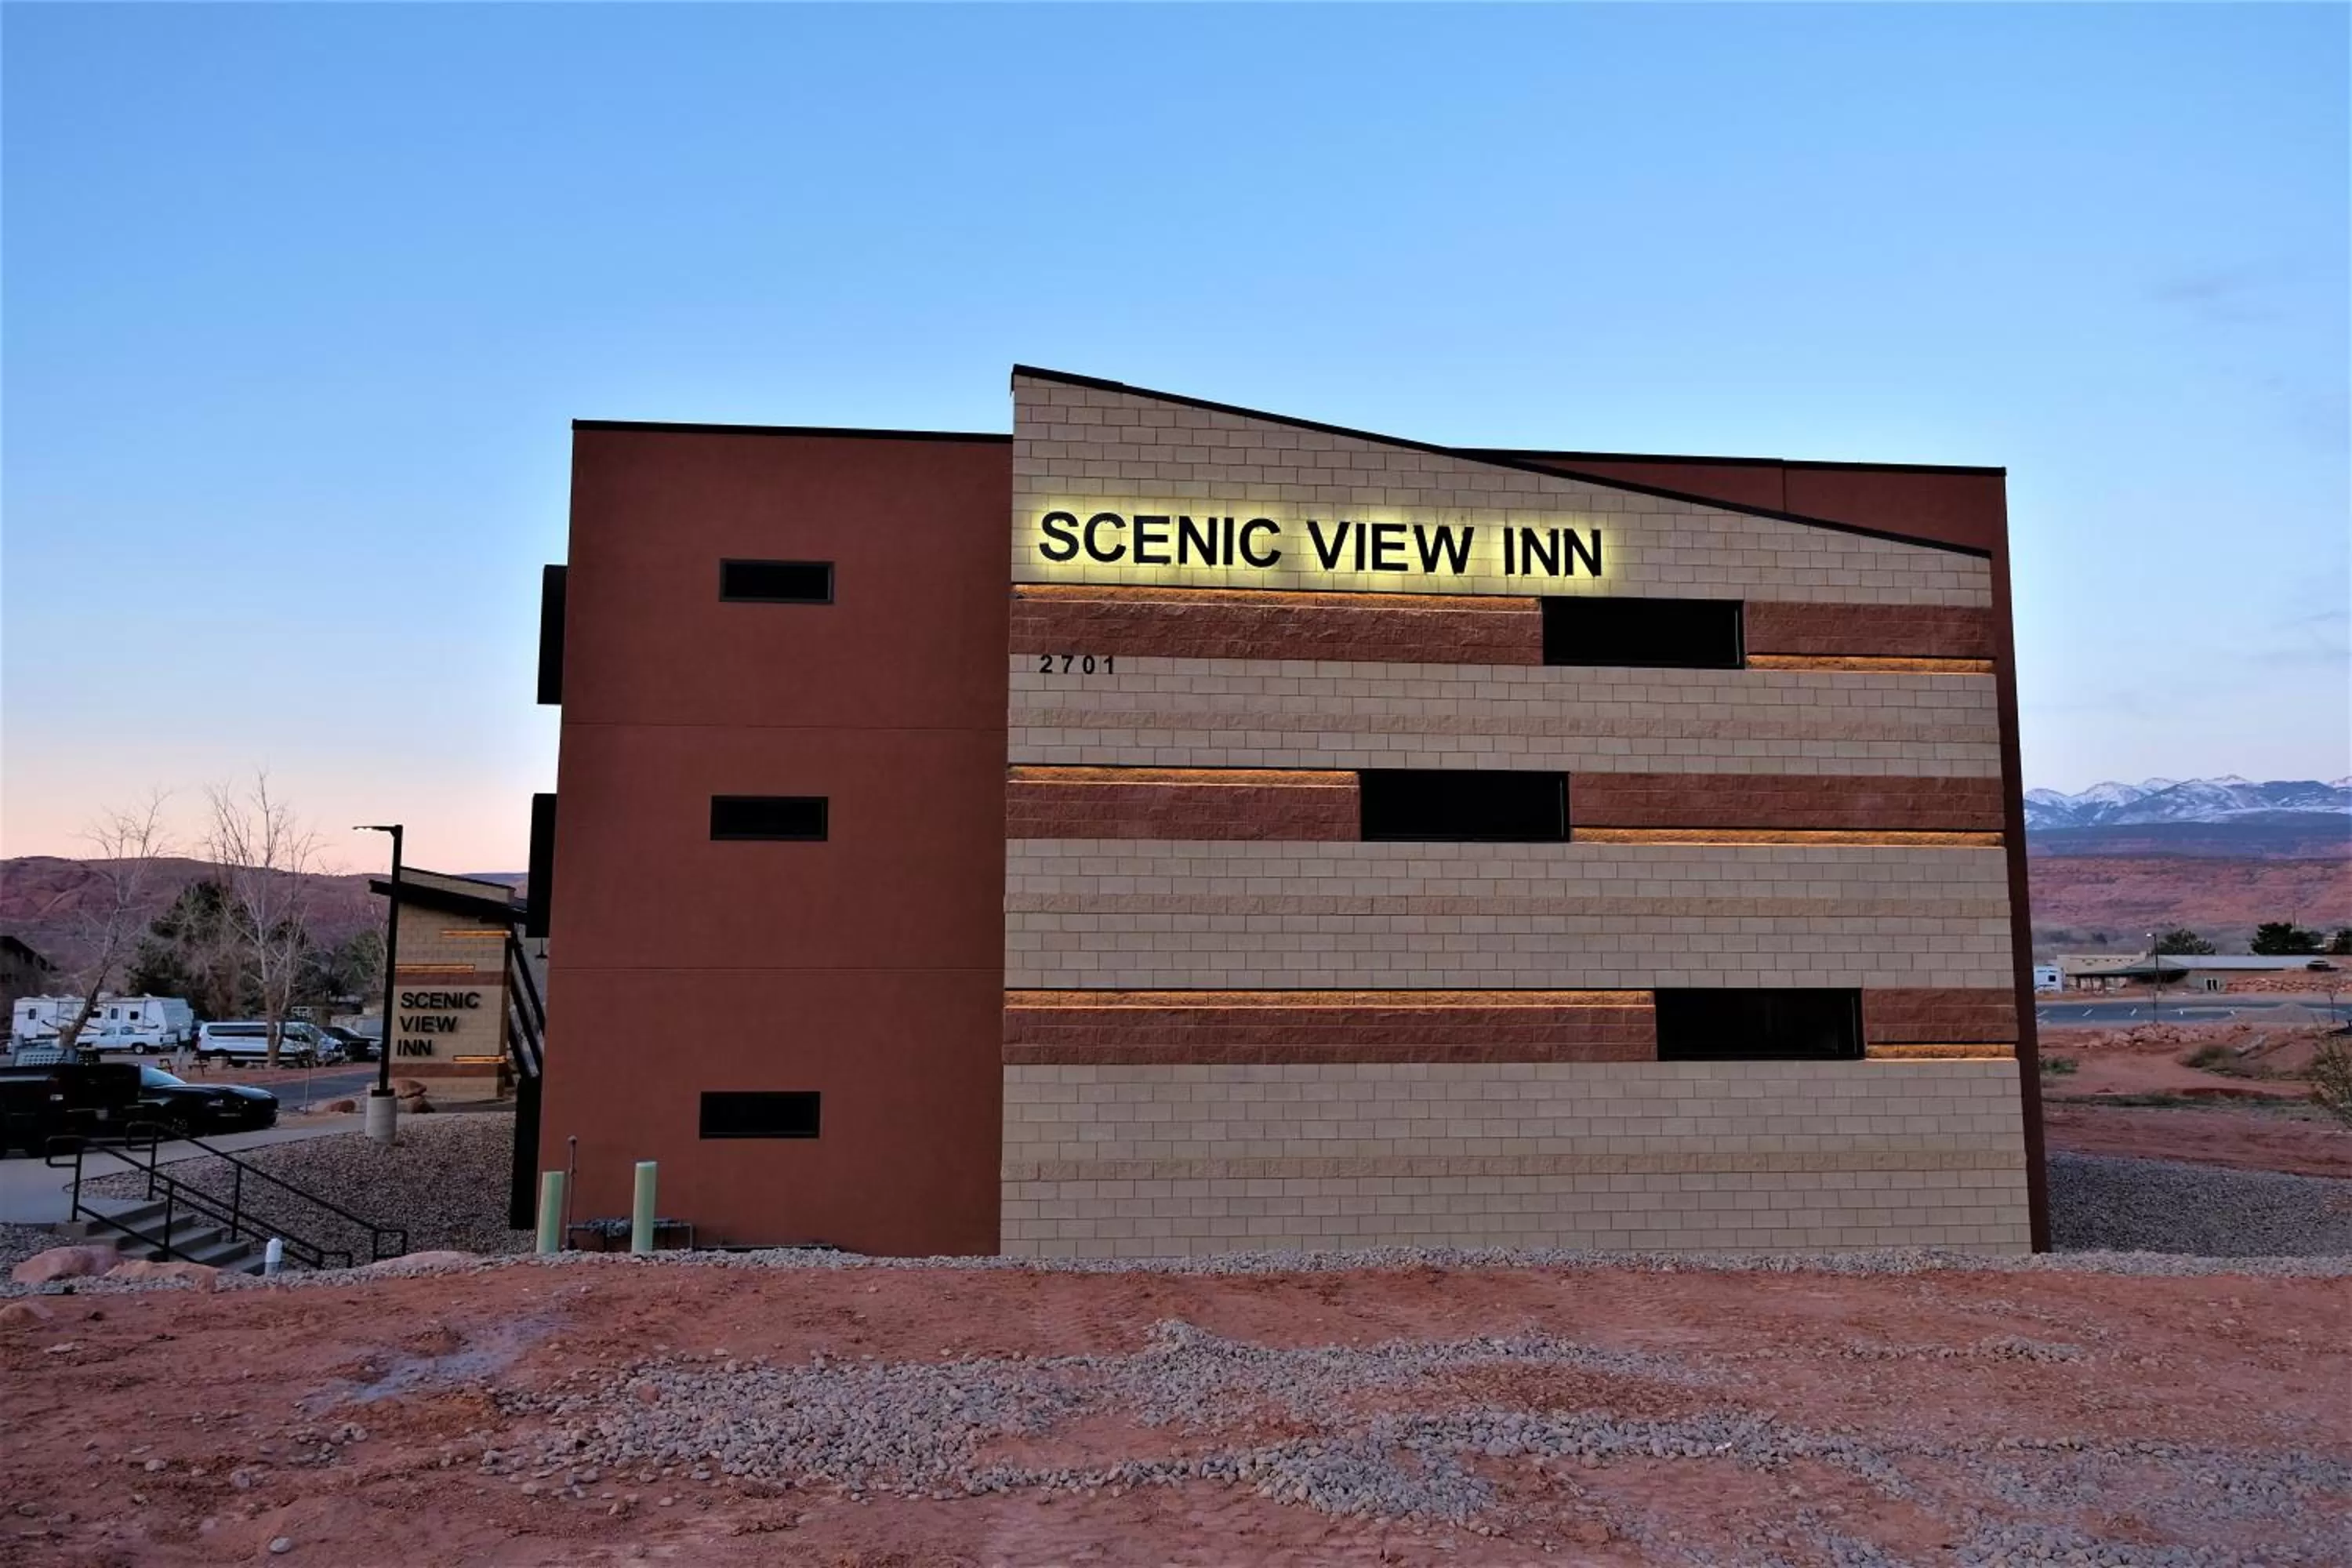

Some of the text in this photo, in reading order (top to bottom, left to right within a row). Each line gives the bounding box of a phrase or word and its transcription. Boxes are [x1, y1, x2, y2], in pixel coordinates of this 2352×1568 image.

[1039, 511, 1602, 577] SCENIC VIEW INN
[1039, 654, 1116, 675] 2701
[401, 991, 481, 1009] SCENIC
[399, 1015, 458, 1033] VIEW
[397, 1039, 433, 1056] INN
